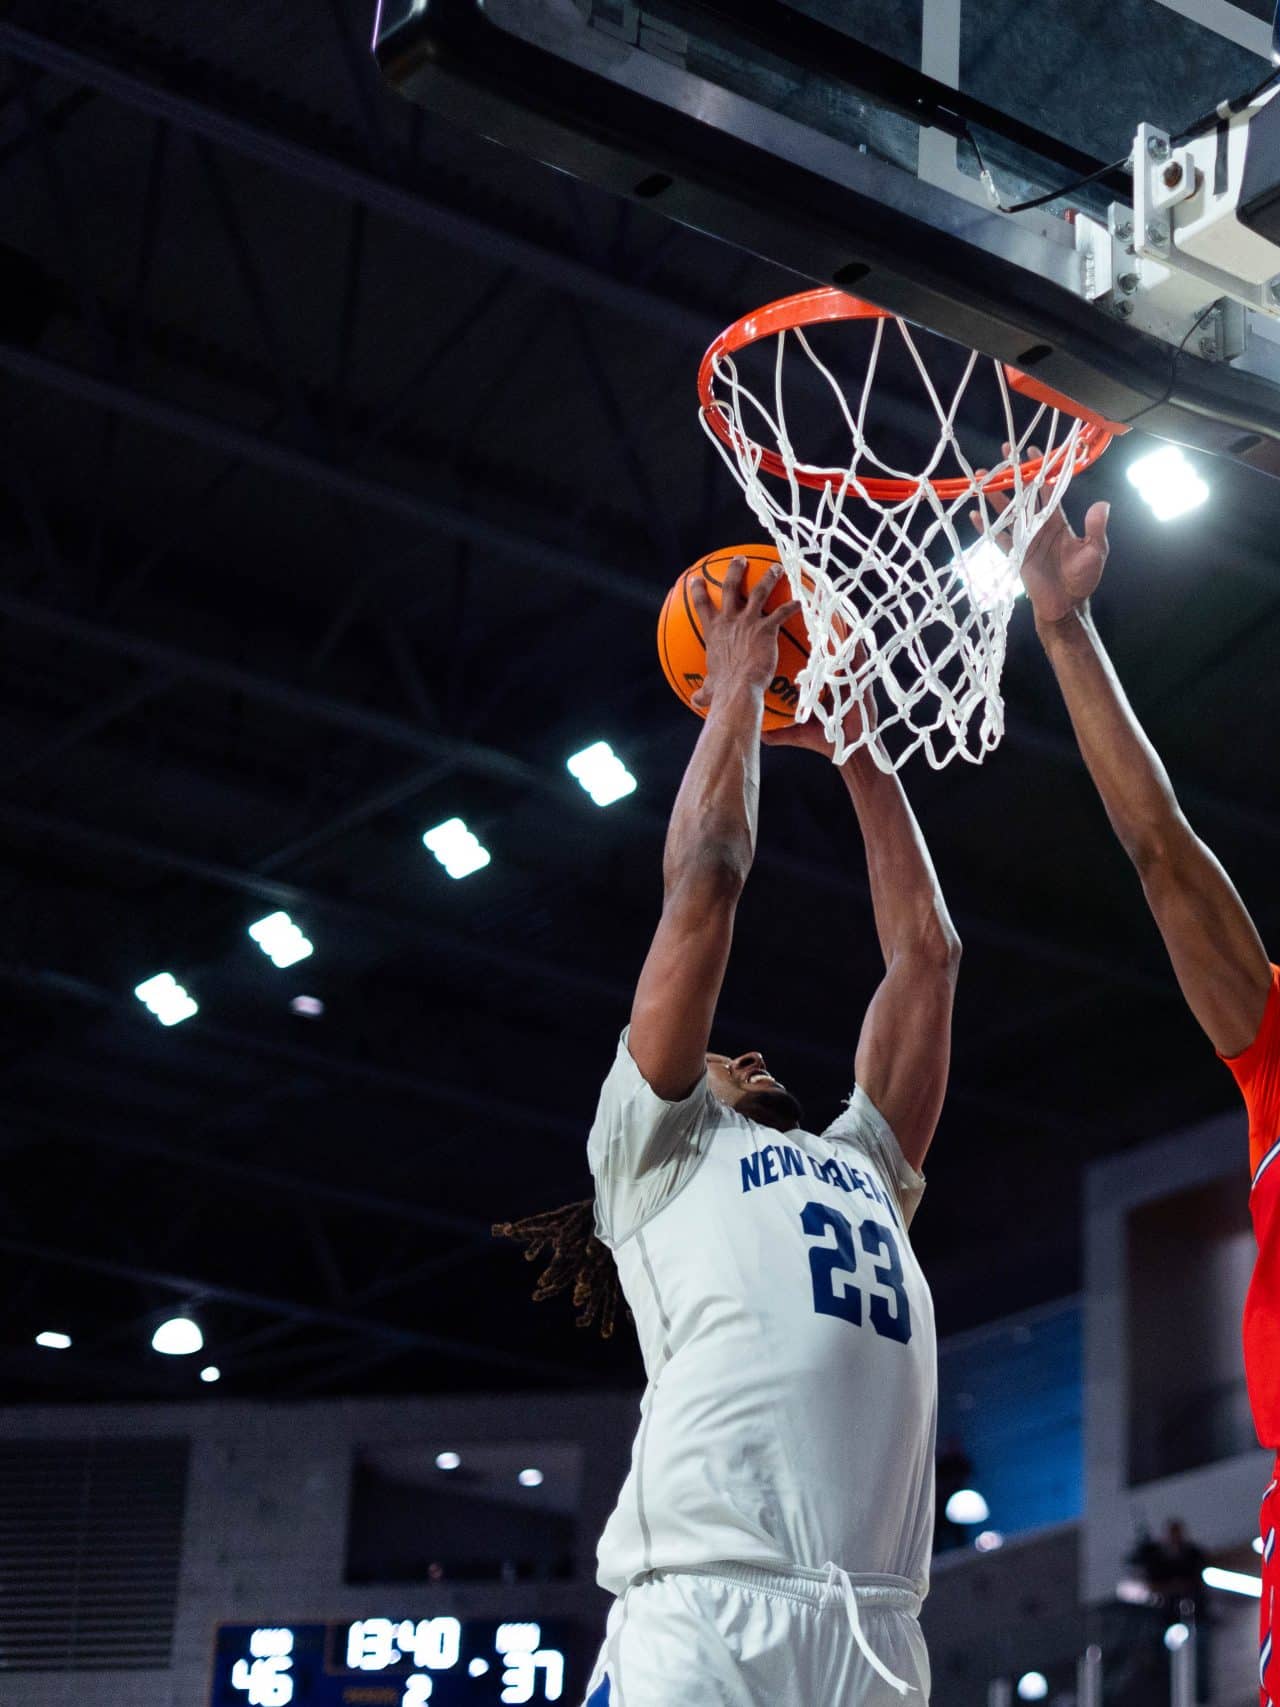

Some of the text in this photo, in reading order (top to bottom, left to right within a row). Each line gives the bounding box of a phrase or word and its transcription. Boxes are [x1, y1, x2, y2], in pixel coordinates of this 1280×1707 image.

[740, 1145, 899, 1228] NEW ORLE
[800, 1201, 912, 1345] 23
[402, 1674, 432, 1707] 2
[501, 1650, 564, 1703] 37
